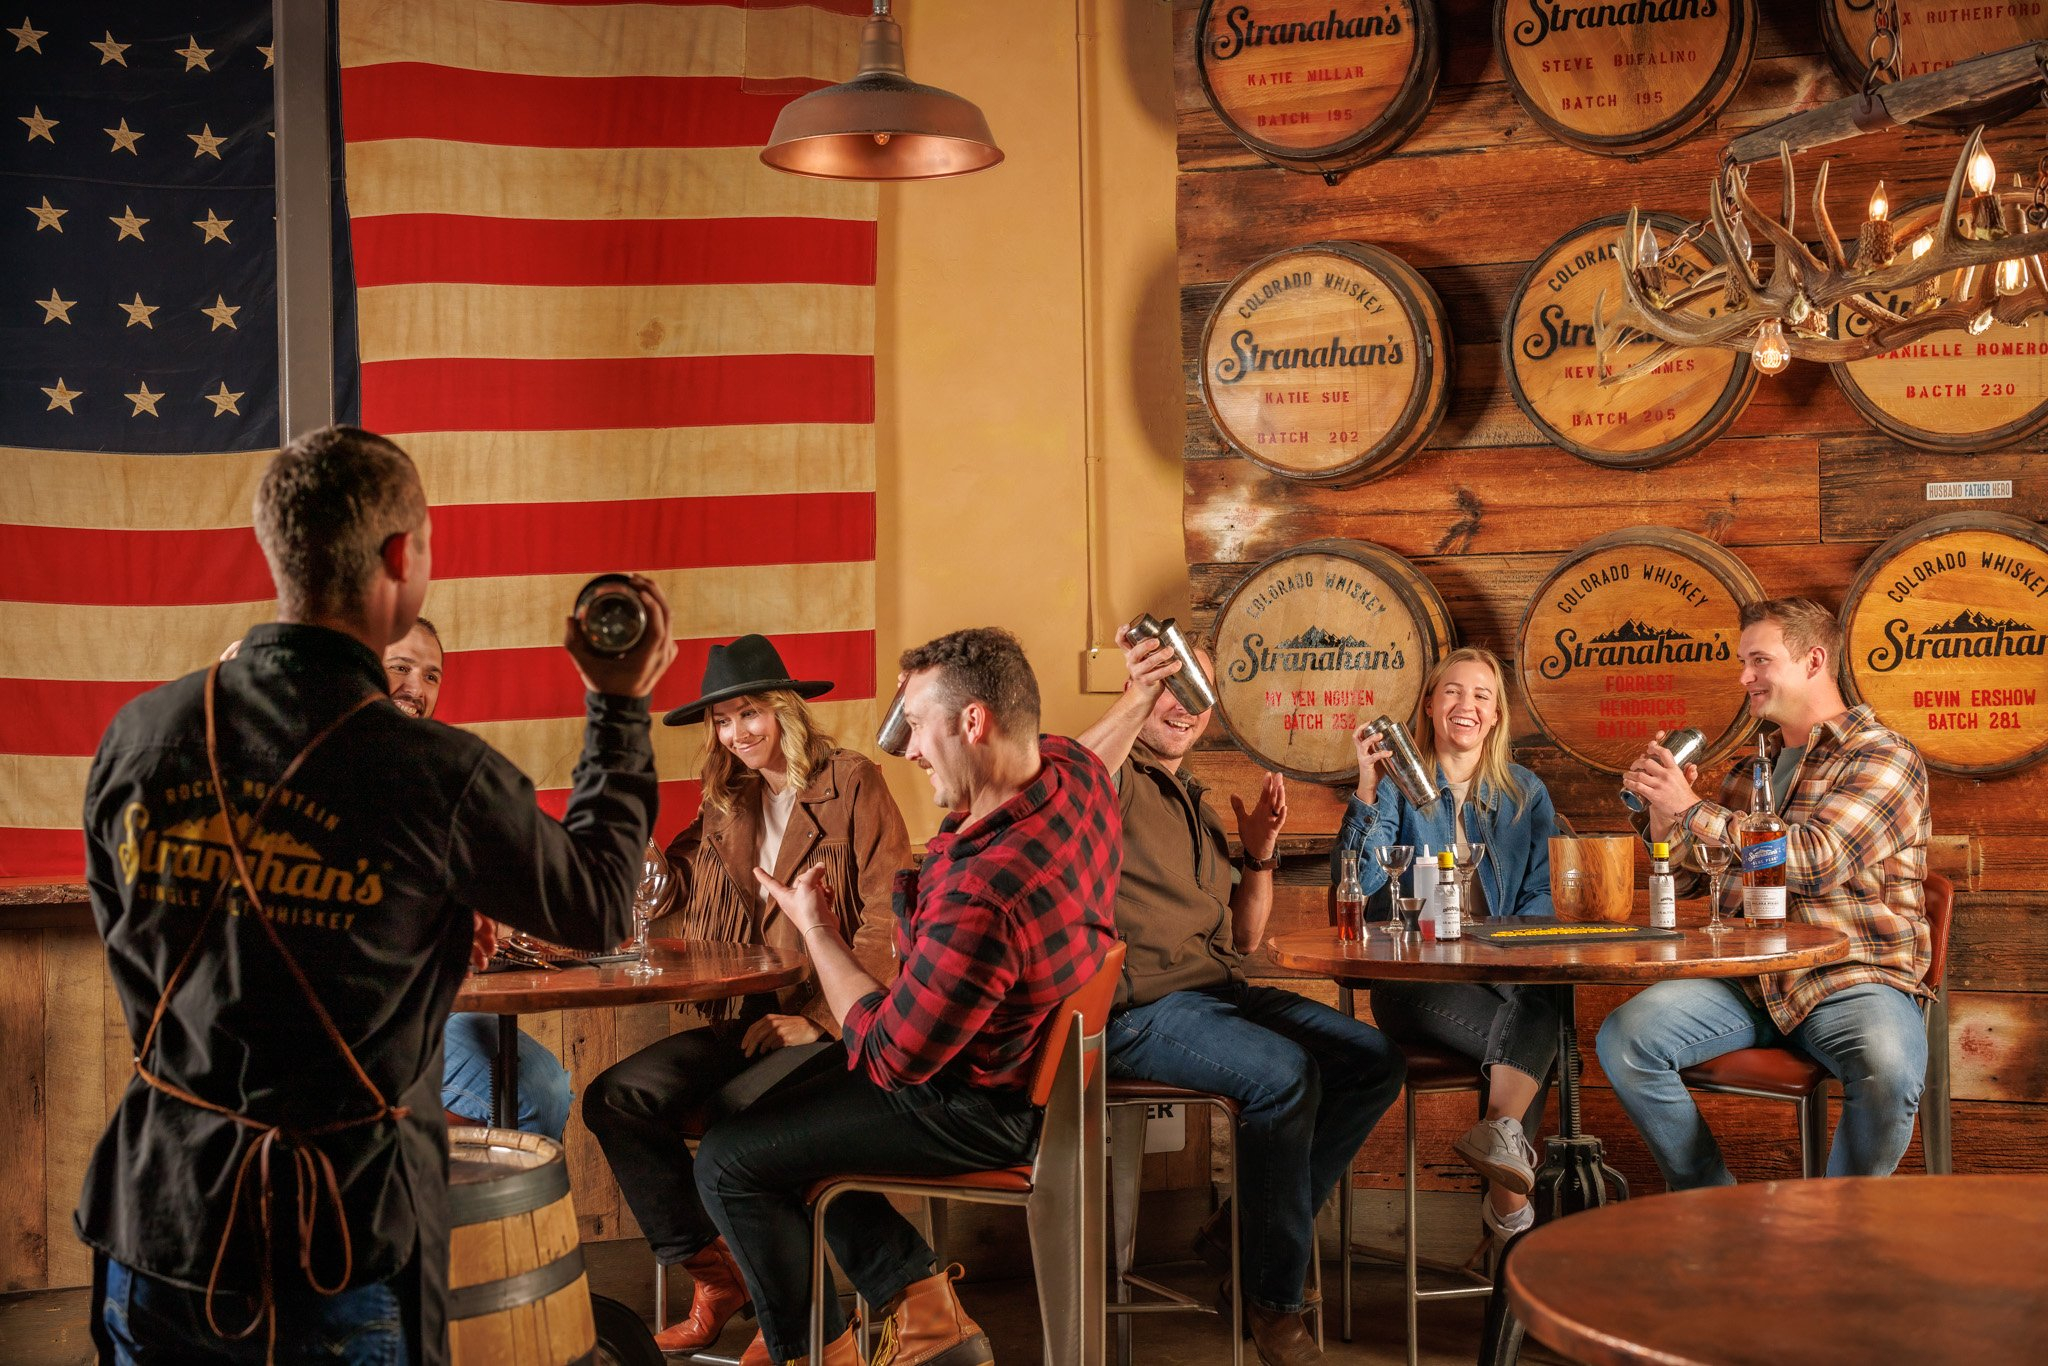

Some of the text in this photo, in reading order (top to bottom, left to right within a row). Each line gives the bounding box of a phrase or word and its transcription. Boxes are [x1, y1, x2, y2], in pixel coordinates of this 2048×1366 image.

[1927, 3, 2041, 24] RUTHERFORD
[1514, 0, 1718, 46] Stranahans
[1211, 5, 1401, 60] Stranahan's
[1542, 50, 1696, 73] STEVE BUFALINO
[1248, 66, 1364, 86] KATIE MILLAR
[1562, 92, 1662, 110] BATCH 195
[1258, 109, 1352, 127] BATCH 195
[1548, 243, 1617, 293] COLORAD
[1238, 271, 1385, 320] COLORADO WHISKEY
[1215, 329, 1404, 385] Stranahan's
[1976, 342, 2048, 356] ROMERO
[1565, 365, 1612, 379] KEVN
[1265, 391, 1350, 404] KATIE SUE
[1906, 383, 2015, 399] BACTH 230
[1572, 409, 1675, 427] BATCH 205
[1257, 431, 1359, 444] BATCH 202
[1929, 482, 2010, 498] HUSBAND FATHER HERO
[1887, 551, 1967, 603] COLORADO
[1246, 571, 1388, 620] COLORADO WHISKEY
[1557, 563, 1708, 614] COLORADO WHISKEY
[1228, 633, 1405, 682] Stranahan's
[1540, 628, 1730, 680] Stranahan's
[1606, 674, 1674, 692] FORREST
[1291, 690, 1315, 706] YEN
[1324, 690, 1374, 706] NGUYEN
[1913, 689, 2036, 708] DEVIN ERSHOW
[1600, 699, 1686, 716] HENDRICKS
[1284, 713, 1357, 731] BATCH 252
[1597, 720, 1648, 737] BATCH
[1928, 712, 2021, 730] BATCH 281
